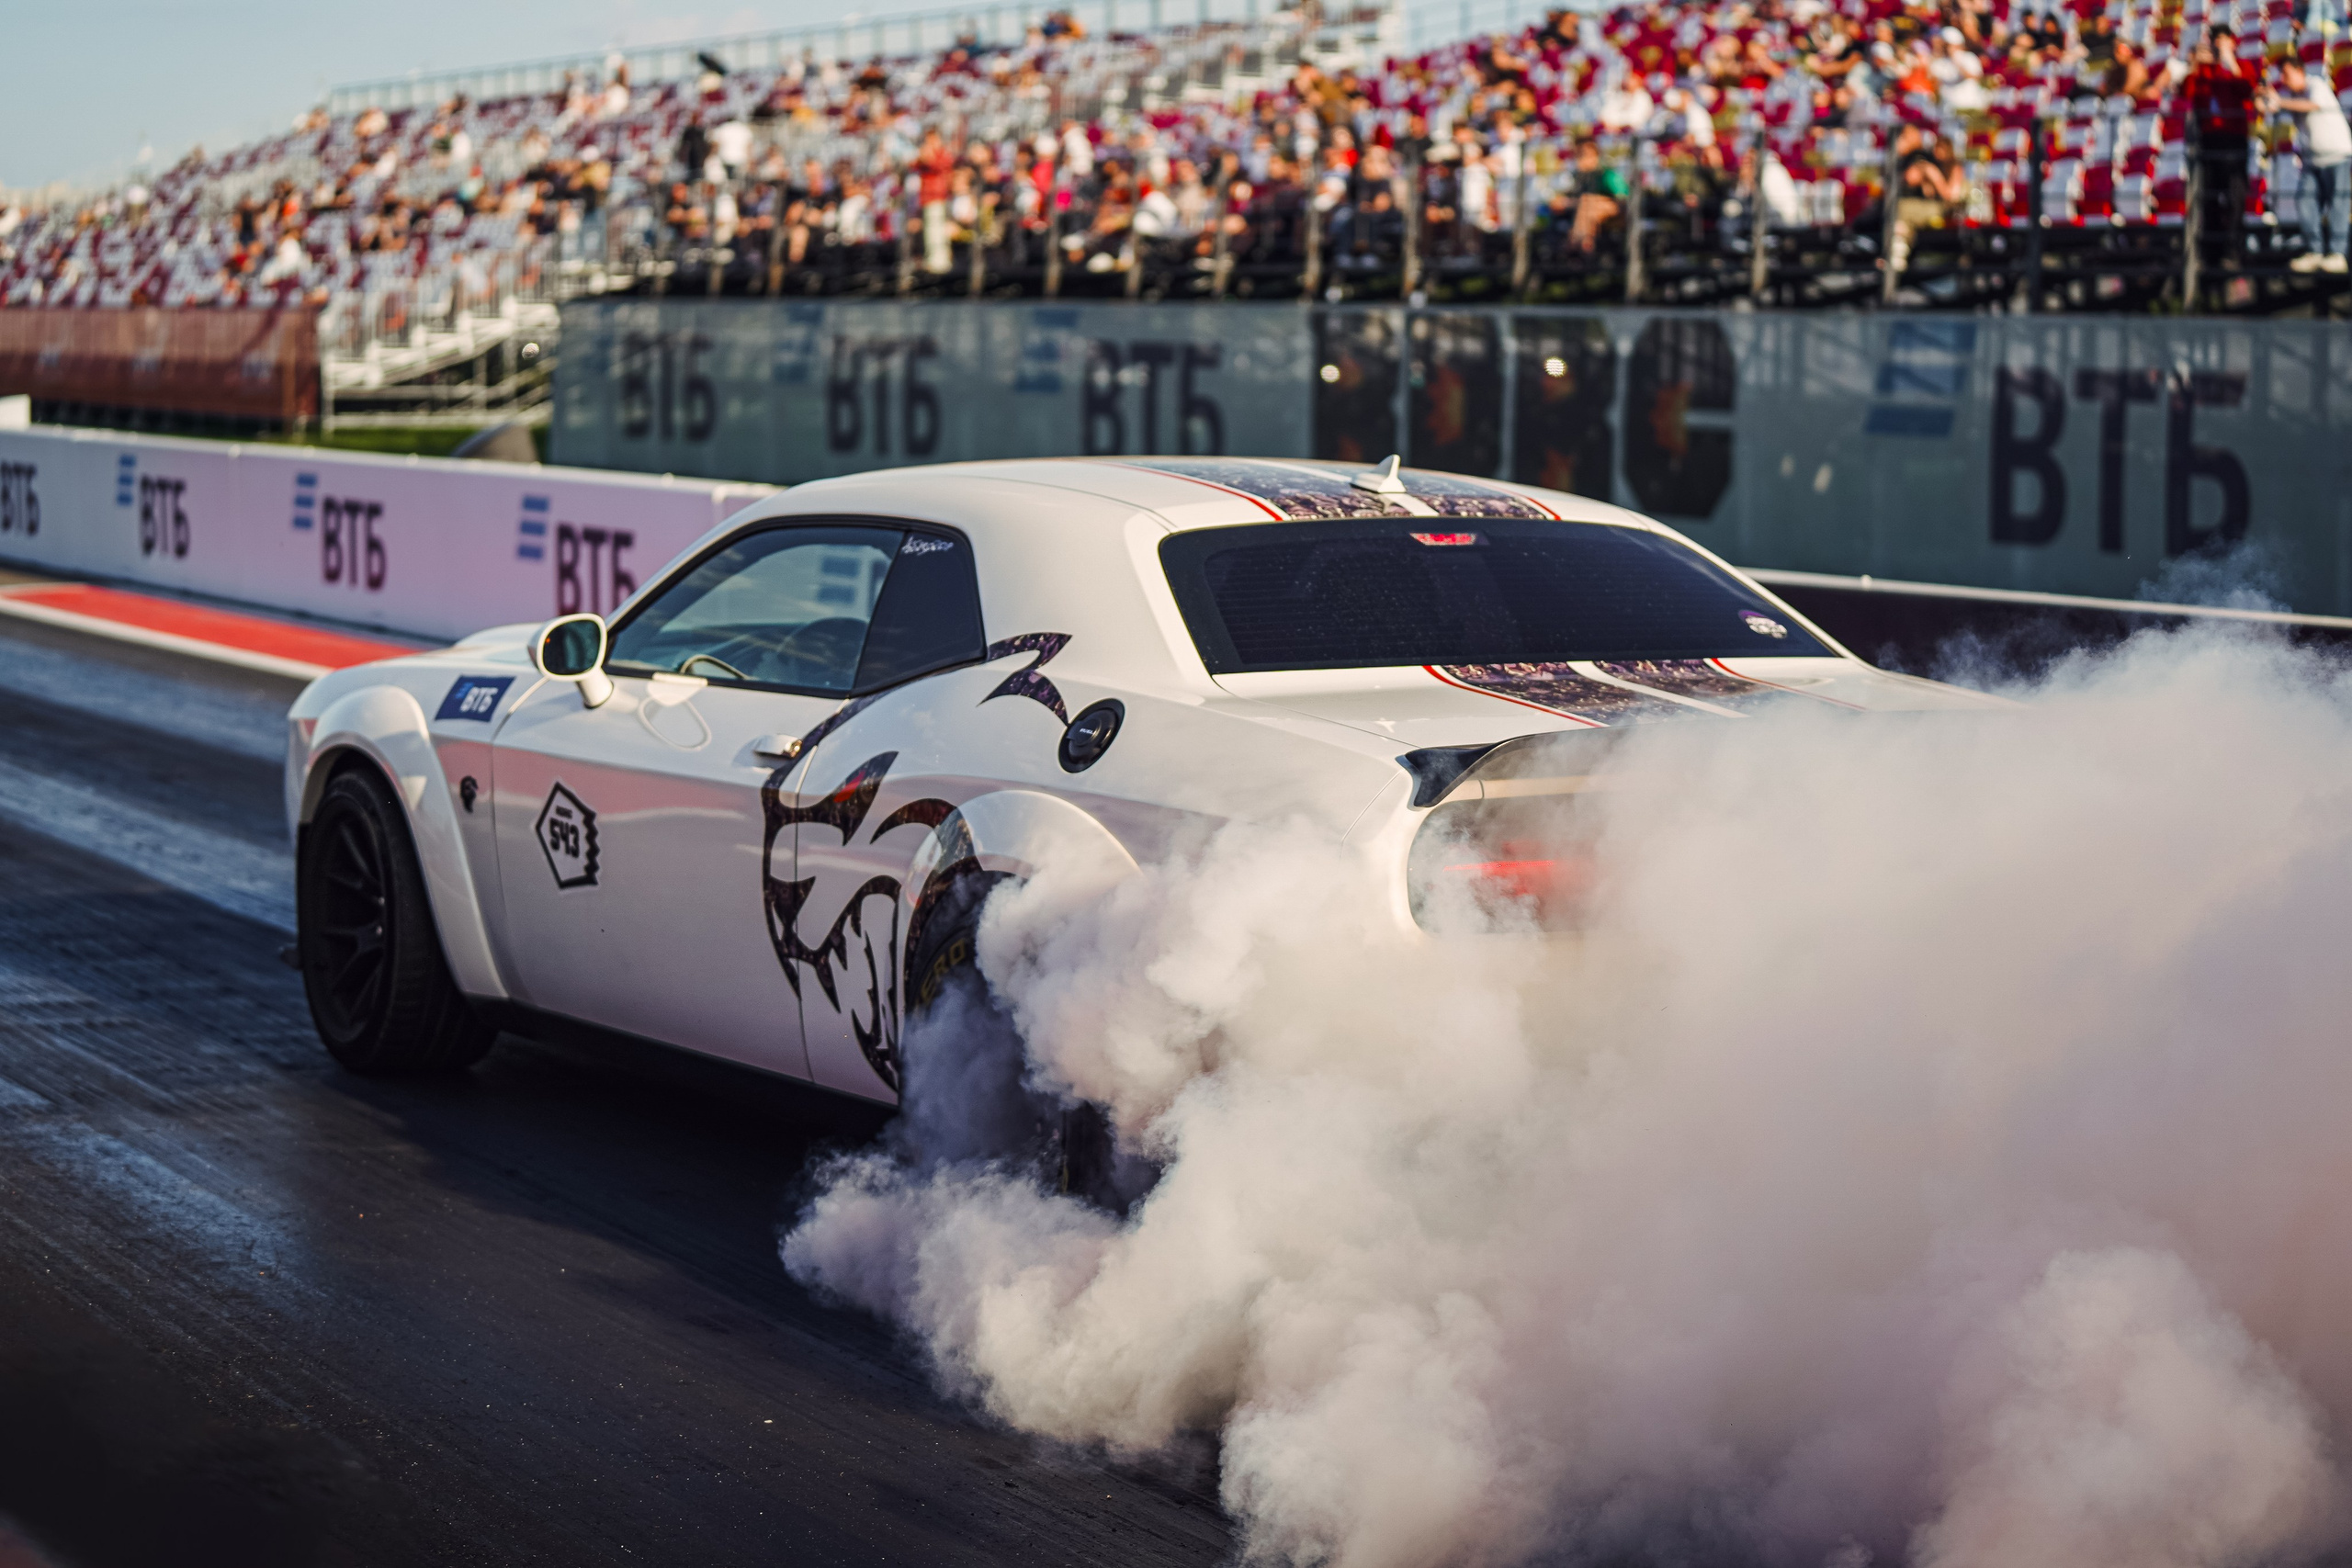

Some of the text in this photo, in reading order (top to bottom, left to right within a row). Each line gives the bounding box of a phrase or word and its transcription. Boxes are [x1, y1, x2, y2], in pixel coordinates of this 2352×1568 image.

[828, 334, 941, 457] ВТБ
[1083, 338, 1224, 457] ВТБ
[0, 462, 40, 536] ВТБ
[1991, 365, 2252, 558] ВТБ
[140, 473, 191, 559] ВТБ
[322, 497, 387, 592] ВТБ
[556, 522, 639, 615] ВТБ
[460, 686, 499, 713] ВТБ
[549, 818, 580, 859] 543
